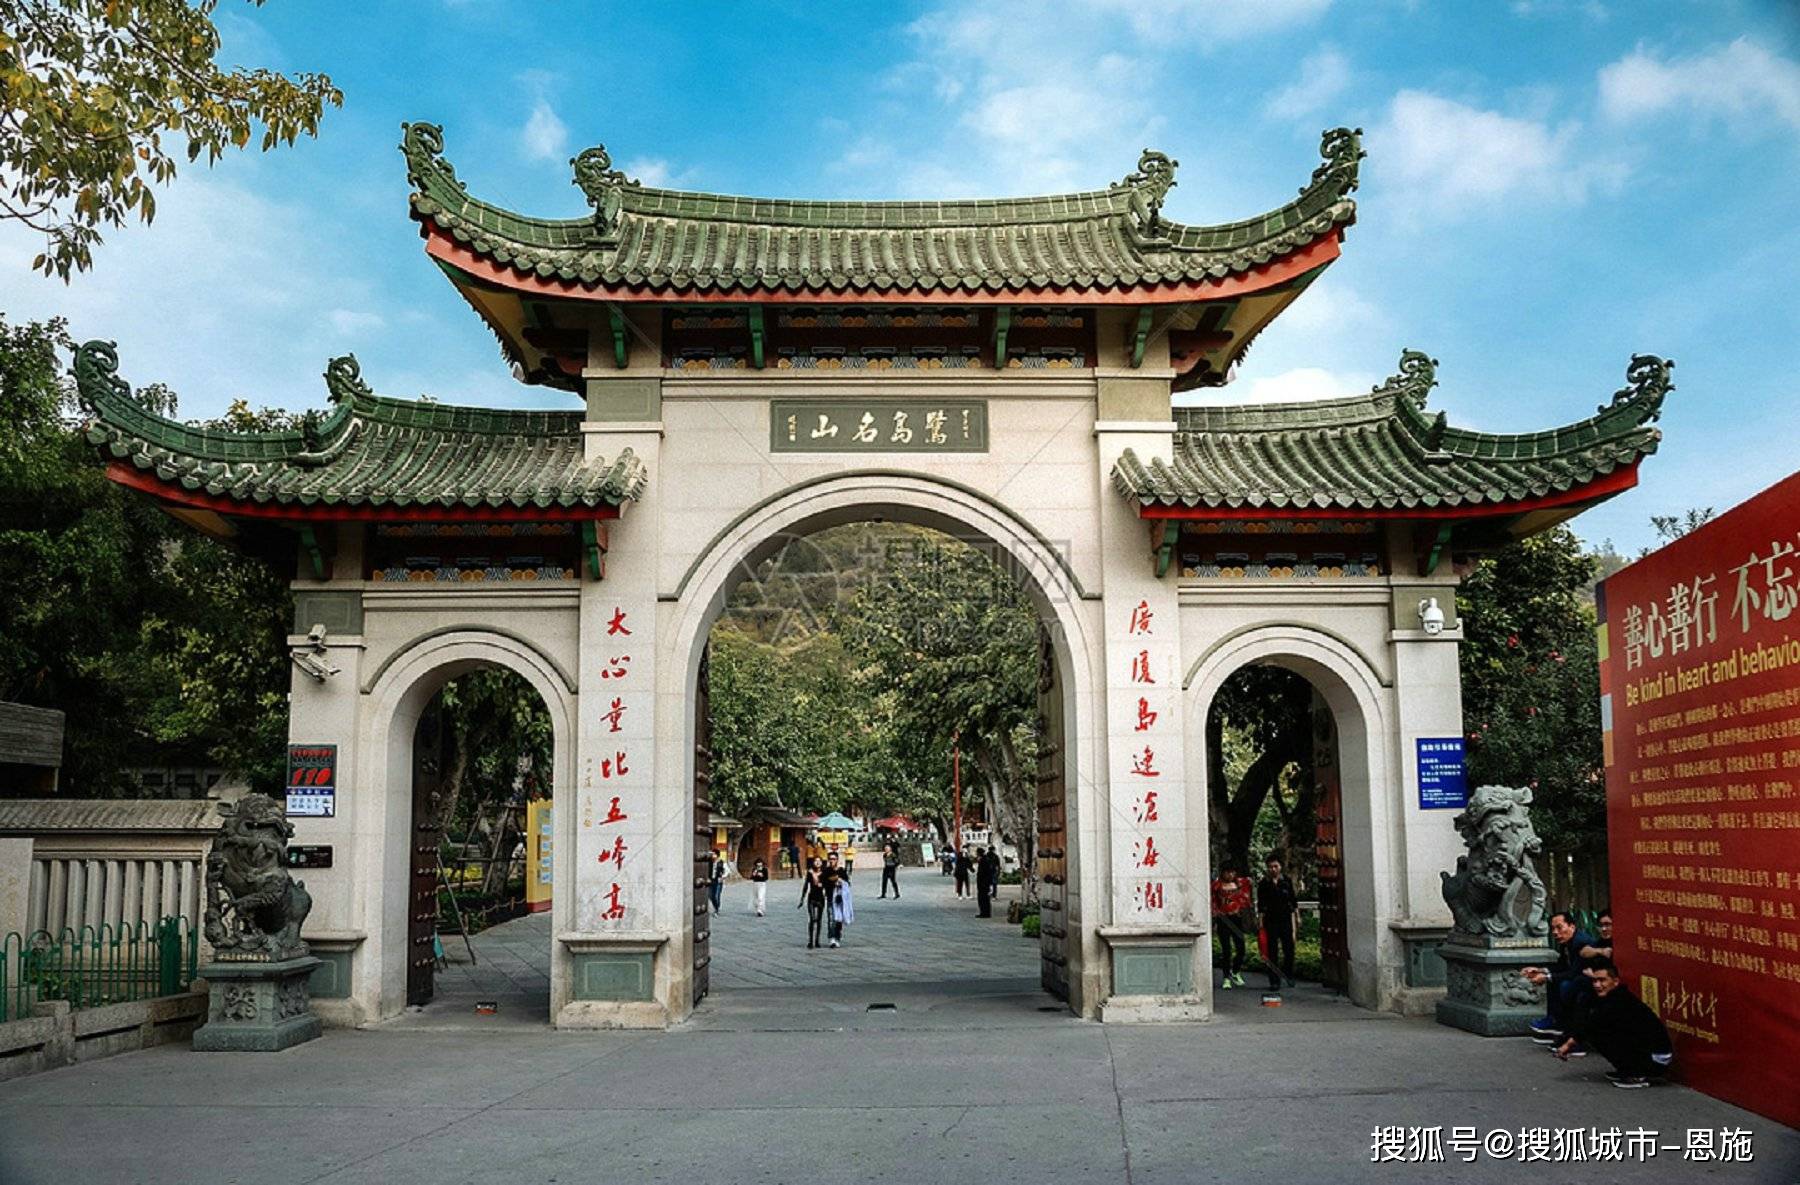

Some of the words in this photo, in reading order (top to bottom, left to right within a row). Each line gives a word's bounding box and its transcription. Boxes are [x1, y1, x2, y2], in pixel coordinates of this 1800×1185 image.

[1622, 573, 1719, 672] 善心善行
[1727, 531, 1800, 634] 不忘
[1626, 683, 1639, 707] Be
[1640, 672, 1663, 702] kind
[1664, 671, 1676, 695] in
[1677, 666, 1710, 692] heart
[1712, 650, 1738, 683] and
[292, 767, 331, 785] 110
